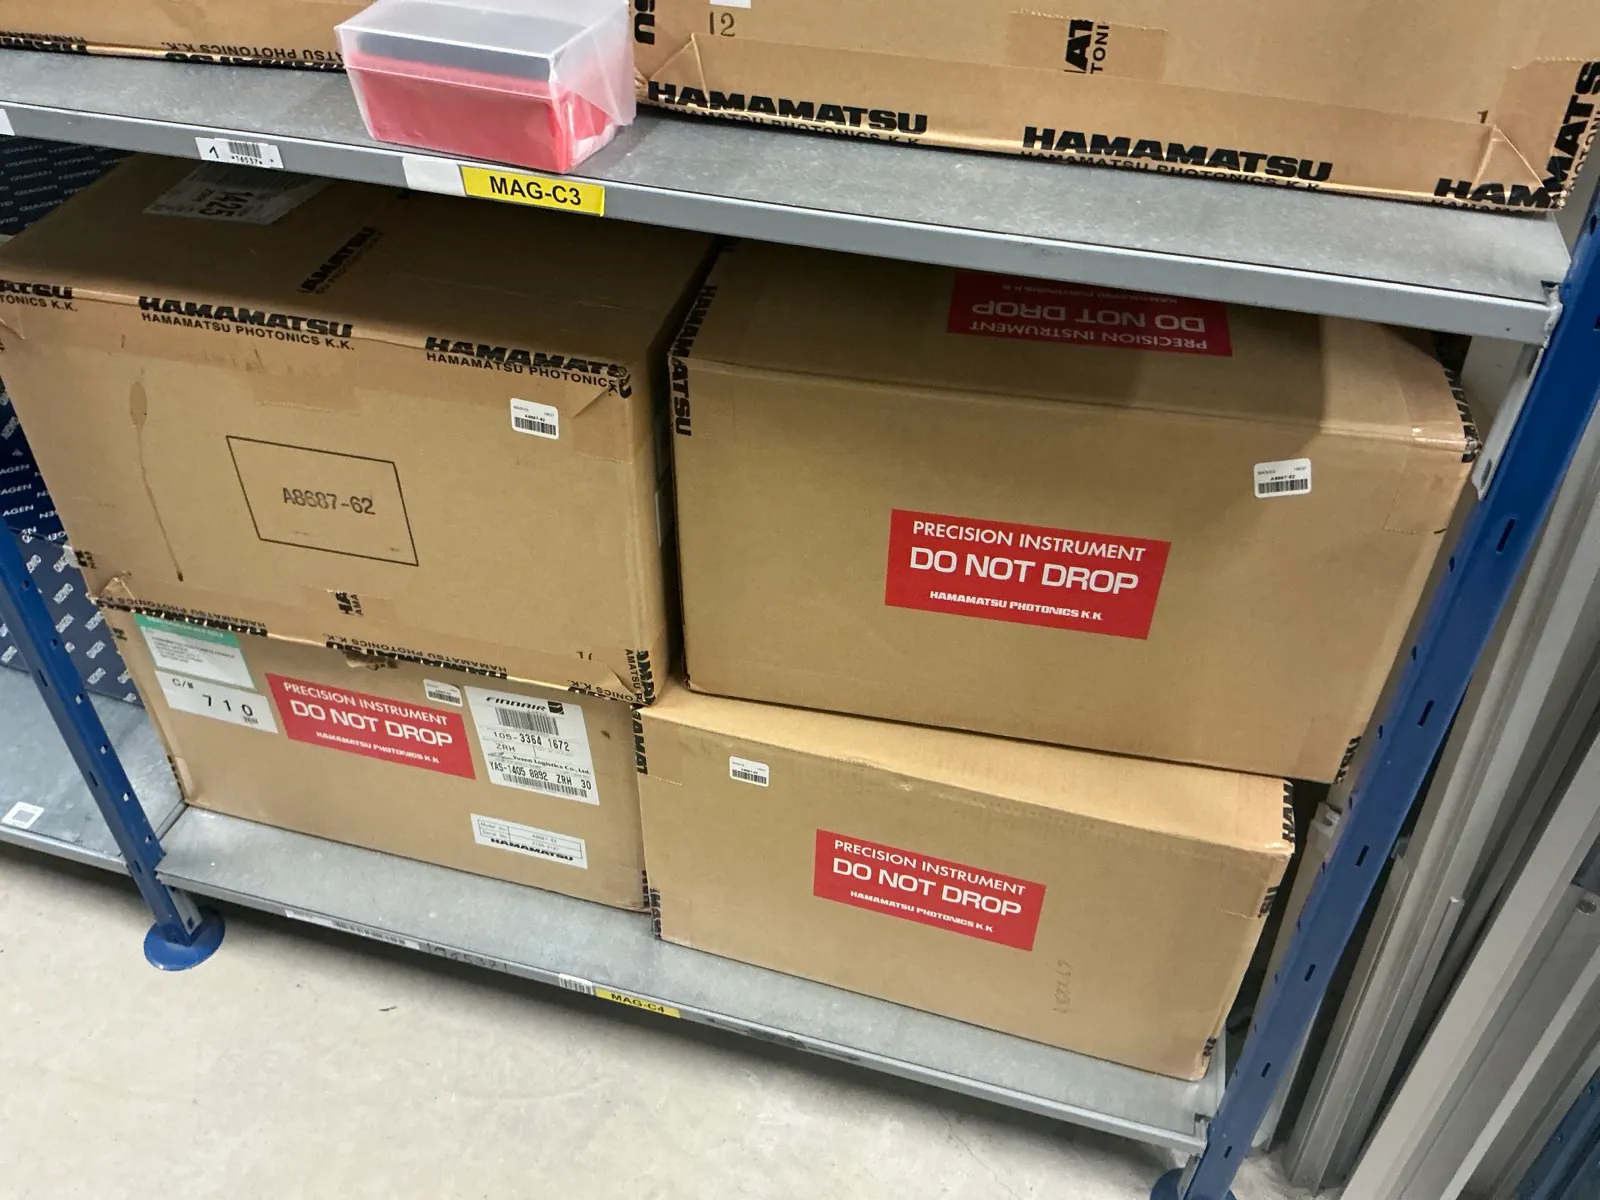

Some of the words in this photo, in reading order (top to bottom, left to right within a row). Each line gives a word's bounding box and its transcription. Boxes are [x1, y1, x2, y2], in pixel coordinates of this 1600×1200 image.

[709, 11, 736, 37] 12
[648, 81, 928, 135] HAMAMATSU
[1022, 125, 1333, 182] HAMAMATSU
[489, 175, 582, 206] MAG-C3
[138, 295, 354, 339] HAMAMATSU
[972, 300, 1066, 321] DROP
[1074, 307, 1146, 329] NOT
[1154, 313, 1205, 333] DO
[141, 312, 232, 334] HAMAMATSU
[237, 326, 320, 347] PHOTONICS
[325, 337, 356, 351] K.K.
[969, 320, 1095, 341] INSTRUMENT
[1102, 332, 1207, 350] PRECISION
[426, 352, 524, 374] HAMAMATSU
[282, 487, 376, 515] A8687-62
[913, 521, 1013, 551] PRECISION
[1019, 537, 1146, 565] INSTRUMENT
[910, 546, 958, 574] DO
[965, 554, 1037, 583] NOT
[1041, 564, 1139, 594] DROP
[930, 591, 1008, 608] HAMAMATSU
[1009, 602, 1079, 618] PHOTONICS
[351, 638, 423, 658] PHOTONICS
[427, 651, 507, 672] HAMAMATSU
[283, 682, 356, 709] PRECISION
[359, 696, 448, 728] INSTRUMENT
[486, 696, 546, 711] FINNAIR
[290, 700, 326, 724] DO
[330, 708, 379, 736] NOT
[385, 721, 453, 750] DROP
[496, 743, 516, 752] ZRH
[548, 738, 570, 752] 1672
[529, 767, 548, 781] 8892
[556, 773, 572, 786] ZRH
[581, 779, 591, 790] 30
[490, 838, 574, 861] HAMAMATSU
[834, 840, 917, 869] PRECISION
[921, 862, 1027, 896] INSTRUMENT
[832, 858, 872, 881] DO
[878, 869, 937, 896] NOT
[941, 886, 1022, 916] DROP
[850, 891, 915, 912] HAMAMATSU
[916, 907, 974, 928] PHOTONICS
[611, 993, 665, 1013] MAG-C4
